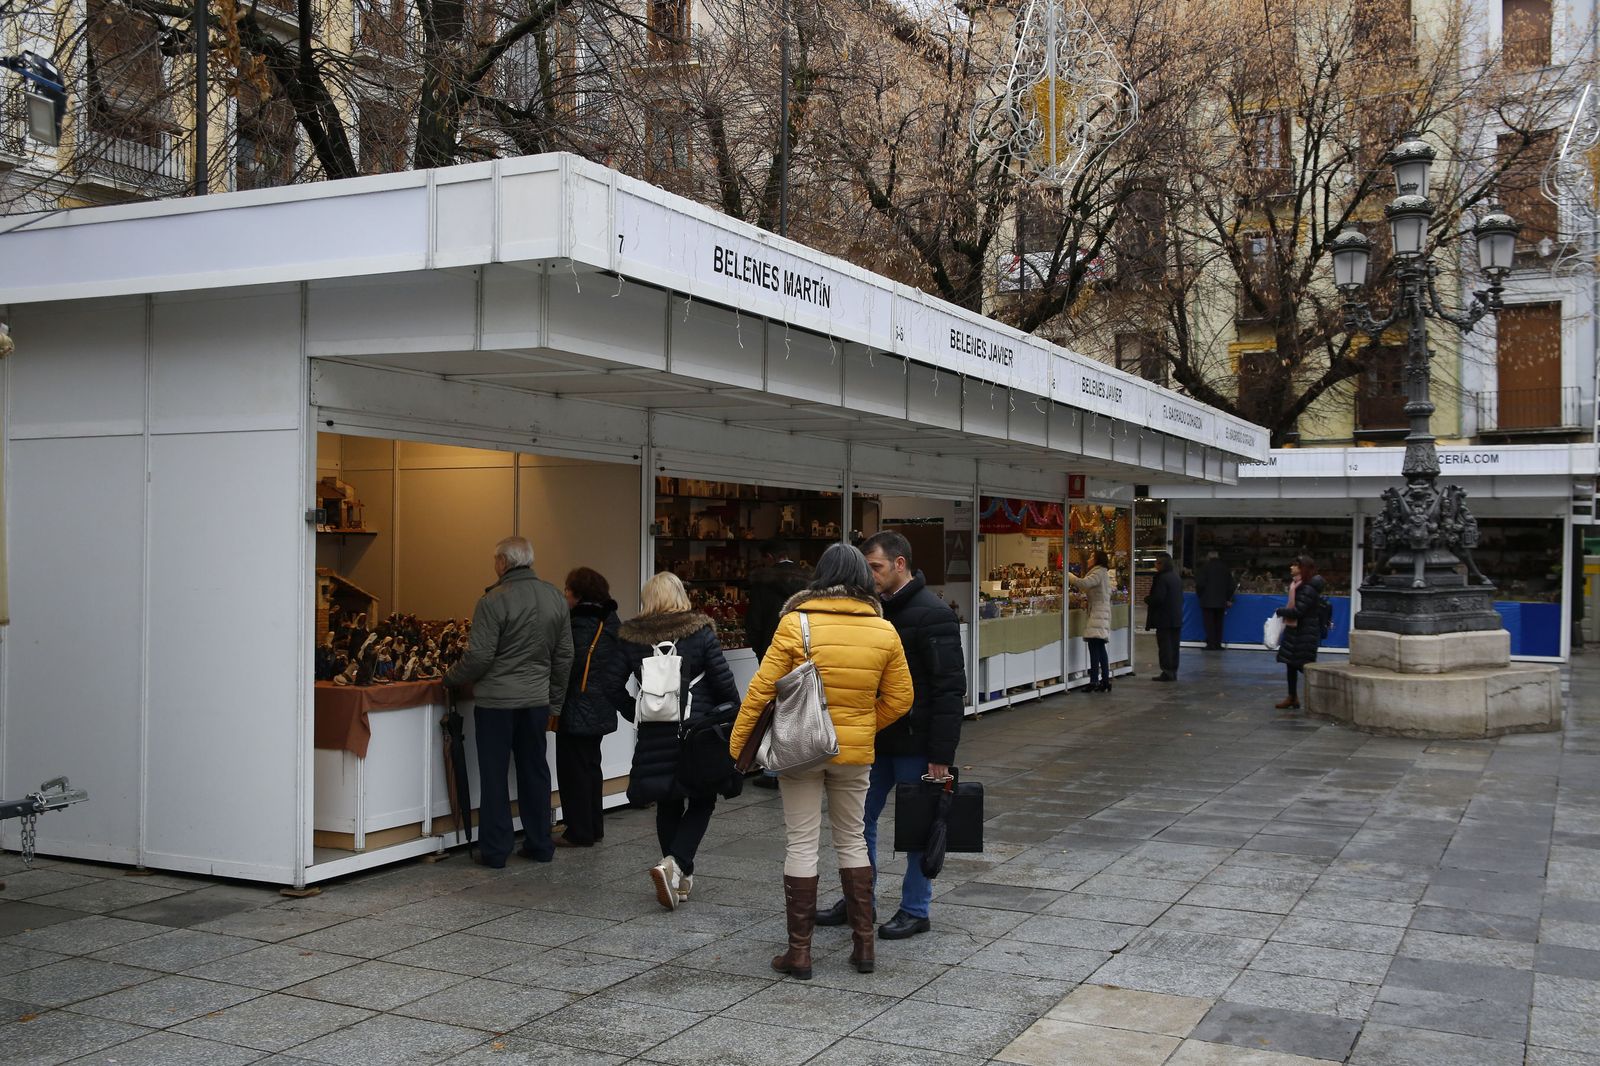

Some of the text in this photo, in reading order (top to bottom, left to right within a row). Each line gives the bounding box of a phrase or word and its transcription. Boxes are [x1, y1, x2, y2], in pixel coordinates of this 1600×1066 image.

[618, 235, 624, 254] 7
[713, 245, 832, 309] BELENES MARTÍN
[950, 328, 1014, 368] BELENES JAVIER
[1081, 376, 1123, 404] BELENES JAVIER
